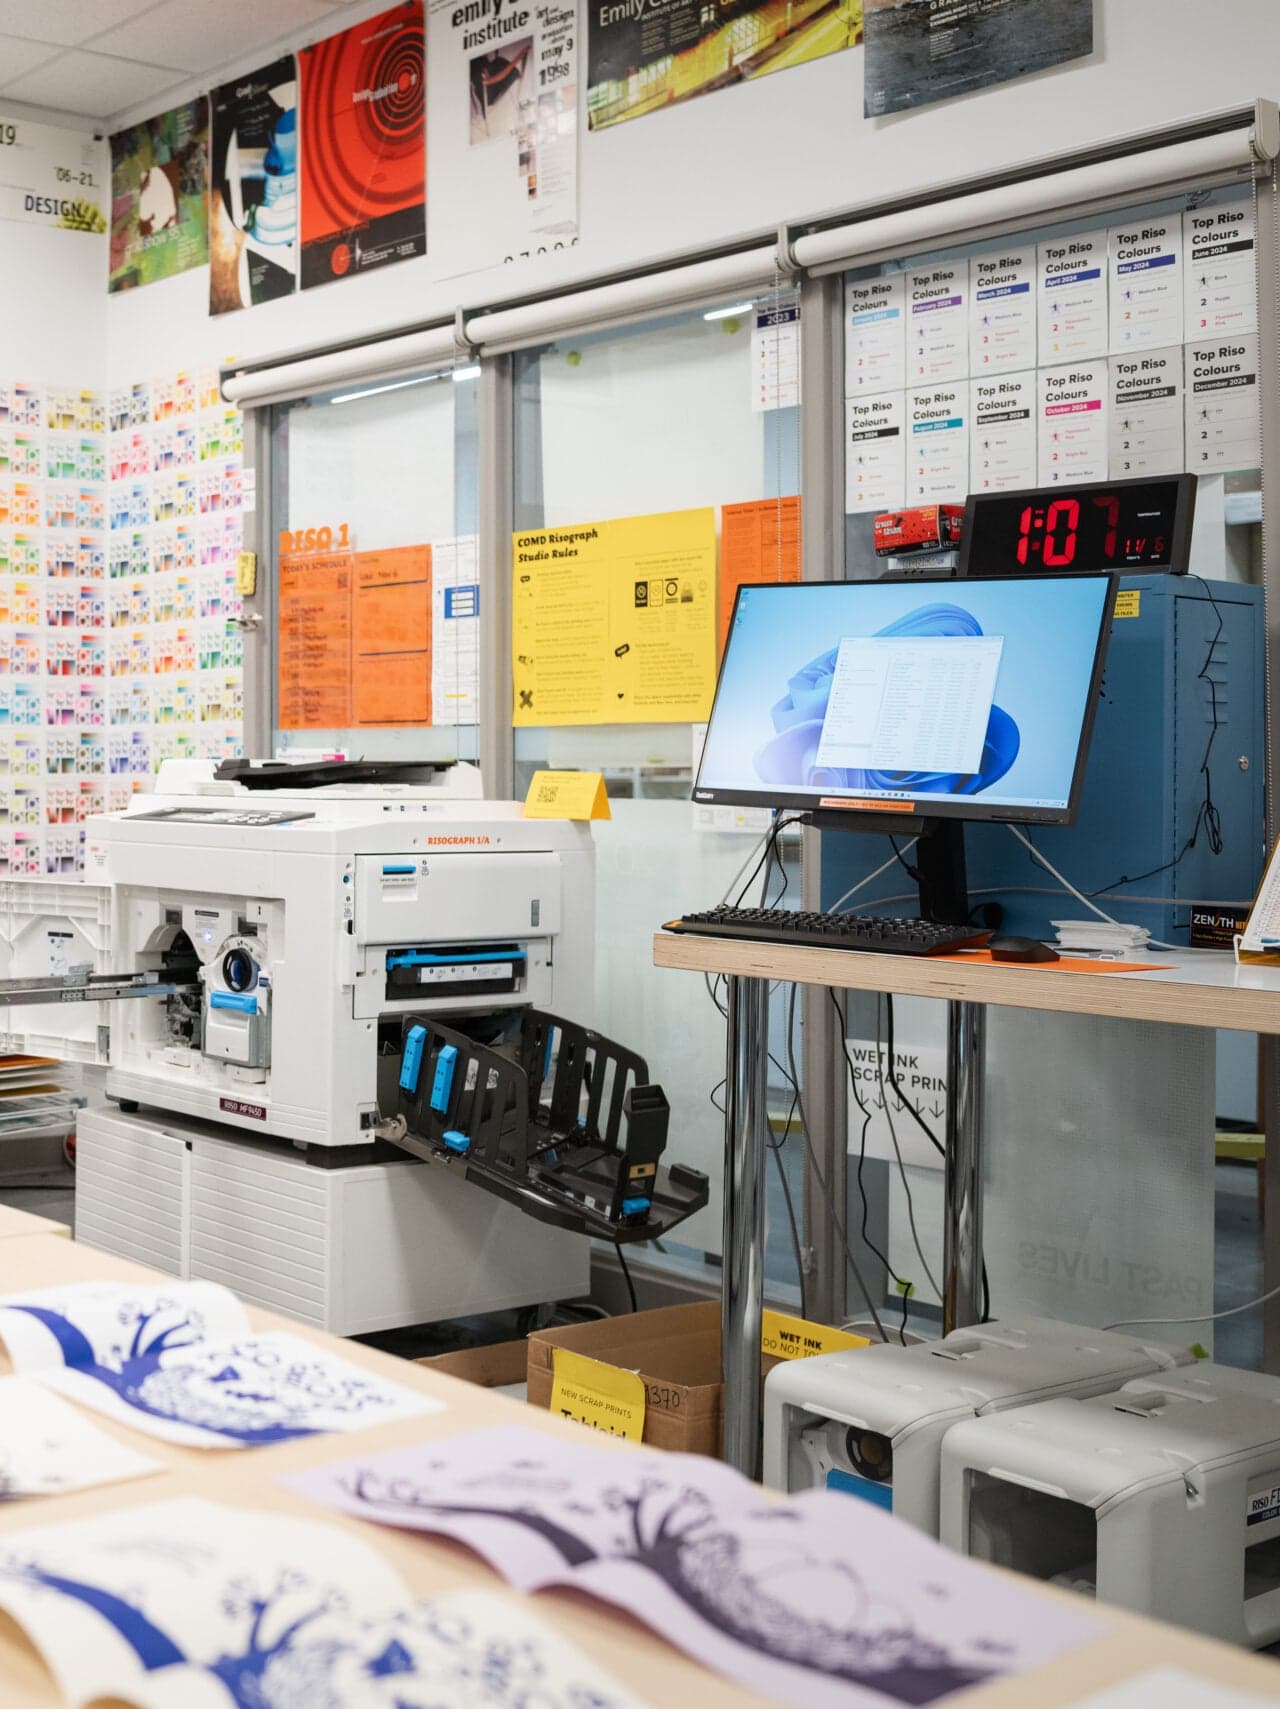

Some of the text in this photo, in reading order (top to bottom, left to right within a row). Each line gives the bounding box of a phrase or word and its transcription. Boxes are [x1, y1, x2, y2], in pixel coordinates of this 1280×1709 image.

[452, 0, 504, 27] emily
[600, 0, 645, 27] Emily
[463, 11, 530, 50] institute
[541, 38, 574, 61] may 9
[25, 195, 81, 218] DESIGN
[1192, 211, 1245, 230] Top Riso
[1117, 227, 1166, 245] Top Riso
[1192, 228, 1239, 246] Colours
[1046, 242, 1093, 260] Top Riso
[1117, 244, 1161, 260] Colours
[1193, 246, 1229, 259] June 2024
[978, 256, 1022, 274] Top Riso
[1046, 258, 1088, 274] Colours
[1118, 261, 1150, 274] May 2024
[913, 270, 954, 287] Top Riso
[977, 273, 1017, 287] Colours
[1046, 274, 1077, 287] April 2024
[853, 284, 892, 300] Top Riso
[913, 287, 950, 300] Colours
[853, 299, 888, 313] Colours
[1193, 345, 1246, 362] Top Riso
[1117, 358, 1166, 374] Top Riso
[1193, 363, 1241, 378] Colours
[1046, 372, 1093, 388] Top Riso
[1117, 376, 1161, 390] Colours
[1194, 376, 1248, 392] December 2024
[978, 382, 1022, 398] Top Riso
[1046, 389, 1088, 402] Colours
[914, 392, 955, 407] Top Riso
[977, 399, 1017, 411] Colours
[853, 402, 893, 416] Top Riso
[914, 408, 951, 420] Colours
[1046, 402, 1088, 416] October 2024
[853, 416, 888, 429] Colours
[337, 524, 350, 547] 1
[518, 528, 598, 548] COMD Risograph
[1016, 496, 1120, 566] 1:07
[518, 547, 578, 563] Studio Rules
[427, 836, 490, 846] RISOGRAPH 1/A
[852, 1048, 886, 1064] WET
[224, 1100, 238, 1110] RISO
[763, 1337, 778, 1349] DO
[780, 1343, 800, 1356] NOT
[779, 1331, 822, 1350] WET INK
[561, 1388, 632, 1419] NEW SCRAP PRINTS
[1252, 1496, 1269, 1512] RISO
